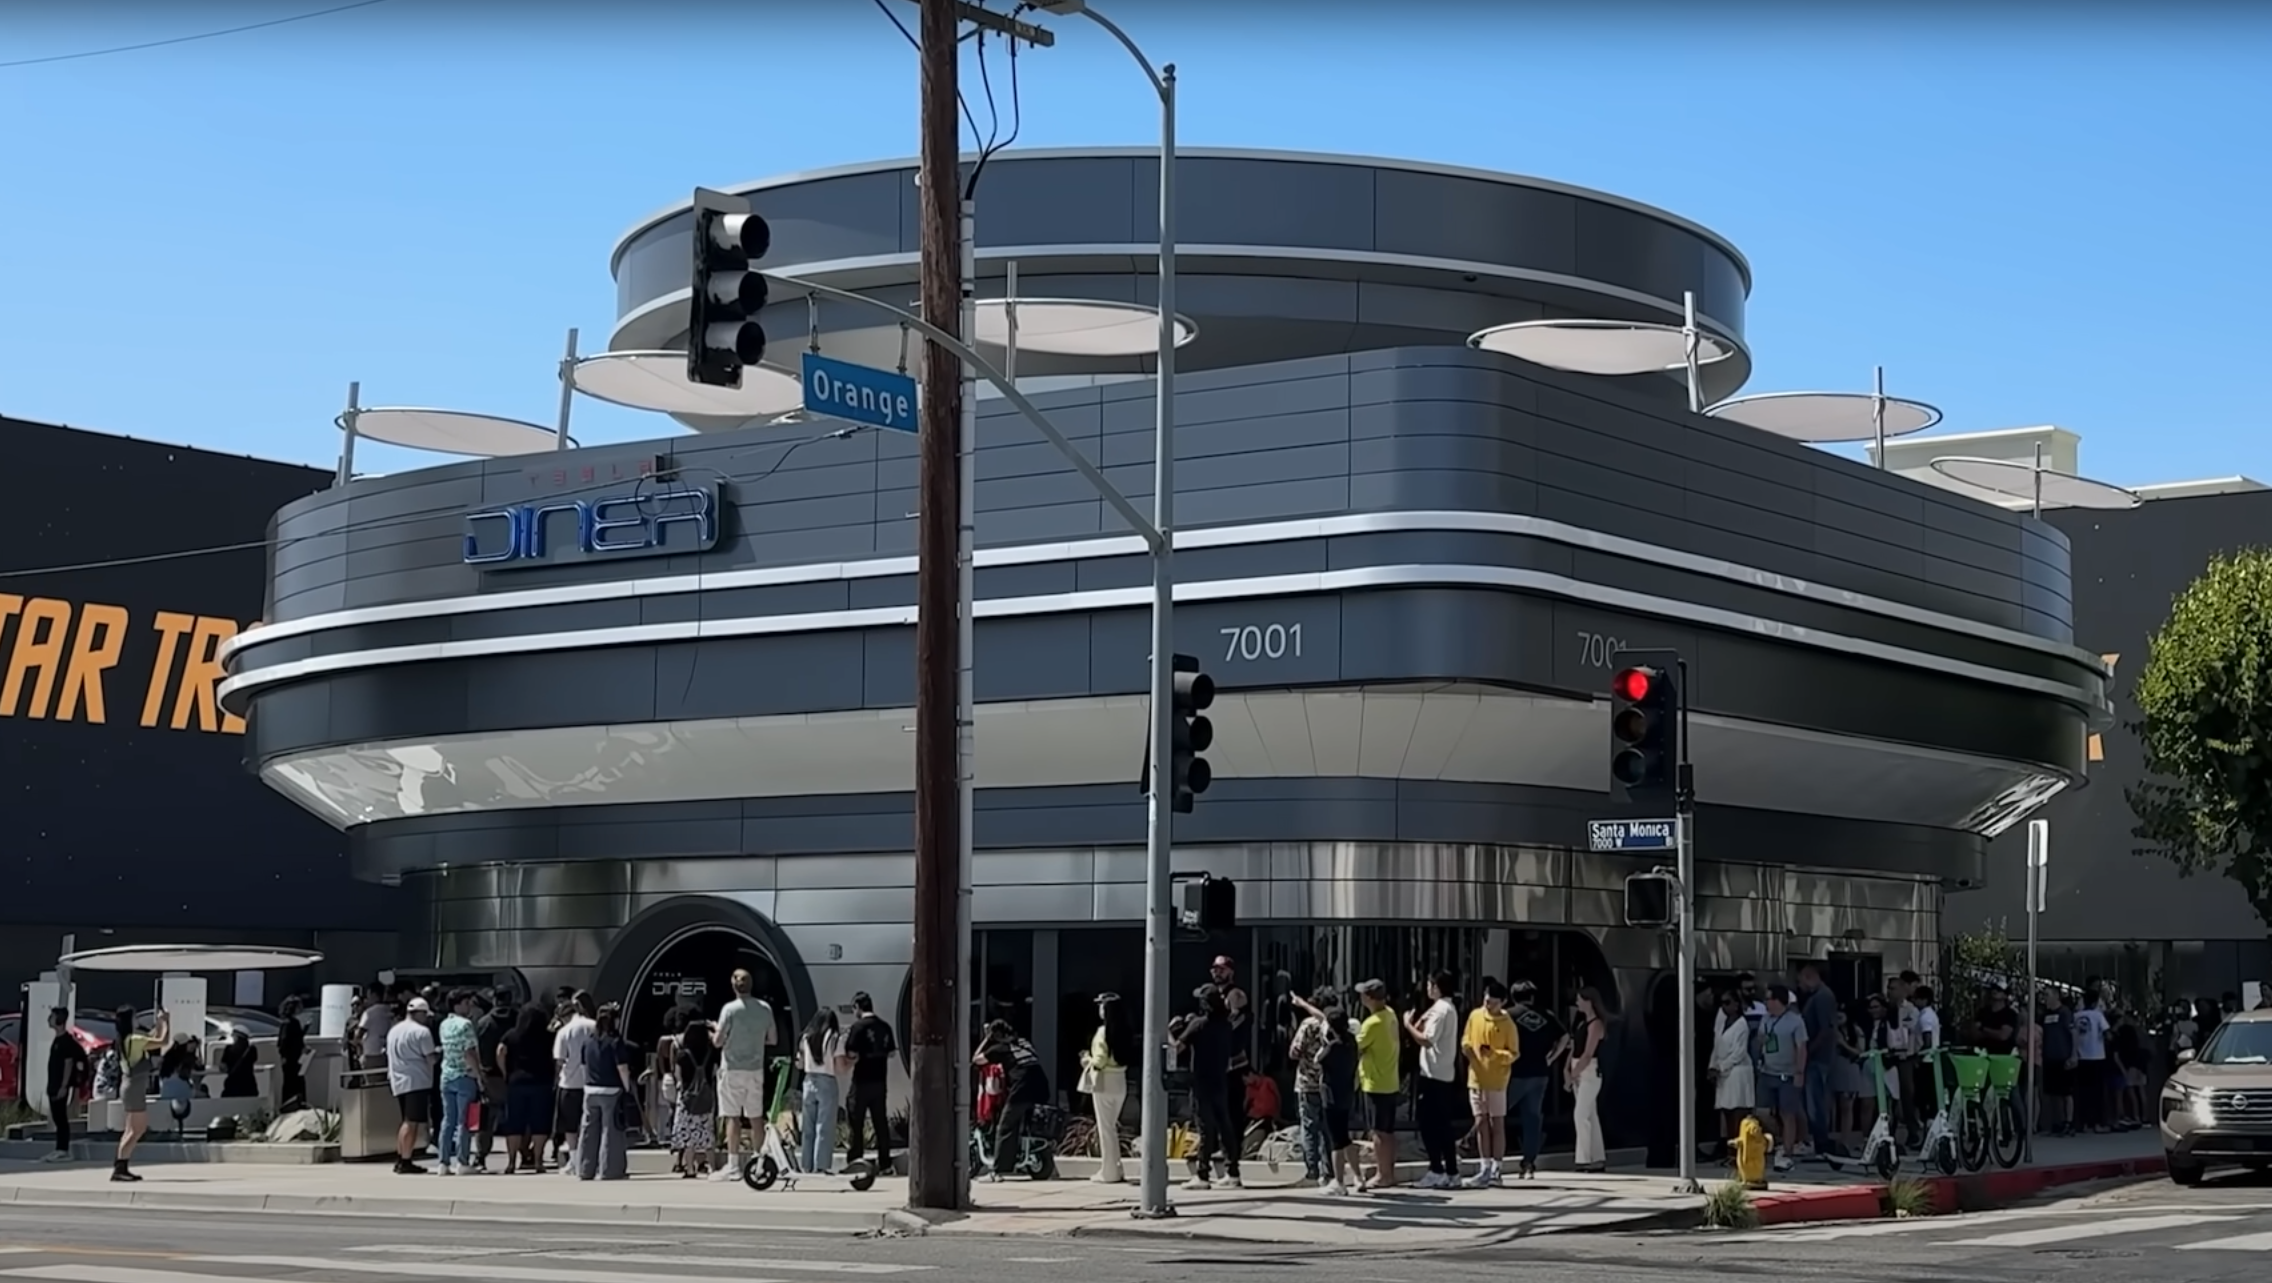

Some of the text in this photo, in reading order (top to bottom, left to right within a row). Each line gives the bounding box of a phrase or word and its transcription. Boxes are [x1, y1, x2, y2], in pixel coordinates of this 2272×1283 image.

[813, 369, 909, 425] Orange
[464, 487, 715, 562] DINER
[1220, 622, 1301, 662] 7001
[140, 611, 247, 734] TR
[1592, 822, 1669, 839] Santa Monica
[652, 981, 708, 996] DINER
